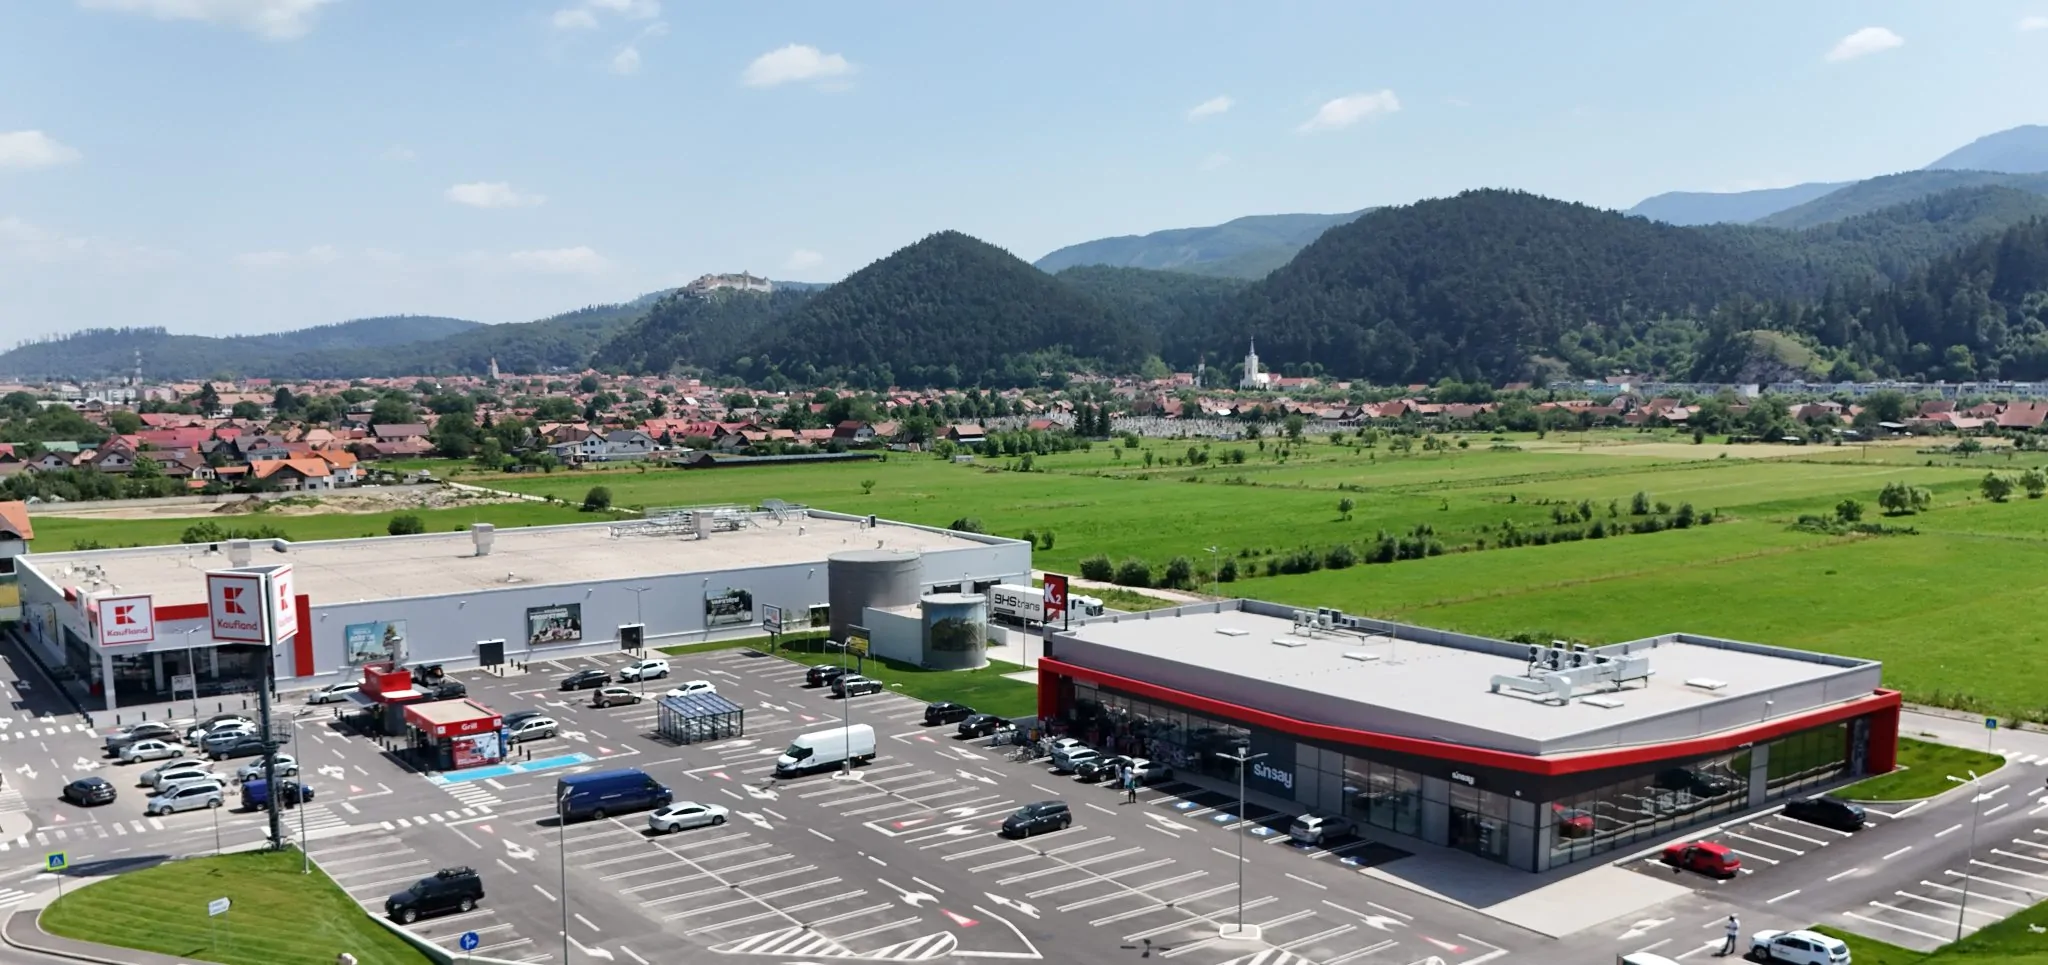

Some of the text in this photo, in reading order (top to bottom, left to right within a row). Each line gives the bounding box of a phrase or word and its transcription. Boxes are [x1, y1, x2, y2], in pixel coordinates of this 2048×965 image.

[217, 618, 258, 631] Kaufland
[107, 626, 148, 637] Kaufland
[461, 722, 478, 731] Grill
[1254, 762, 1292, 788] sinsay
